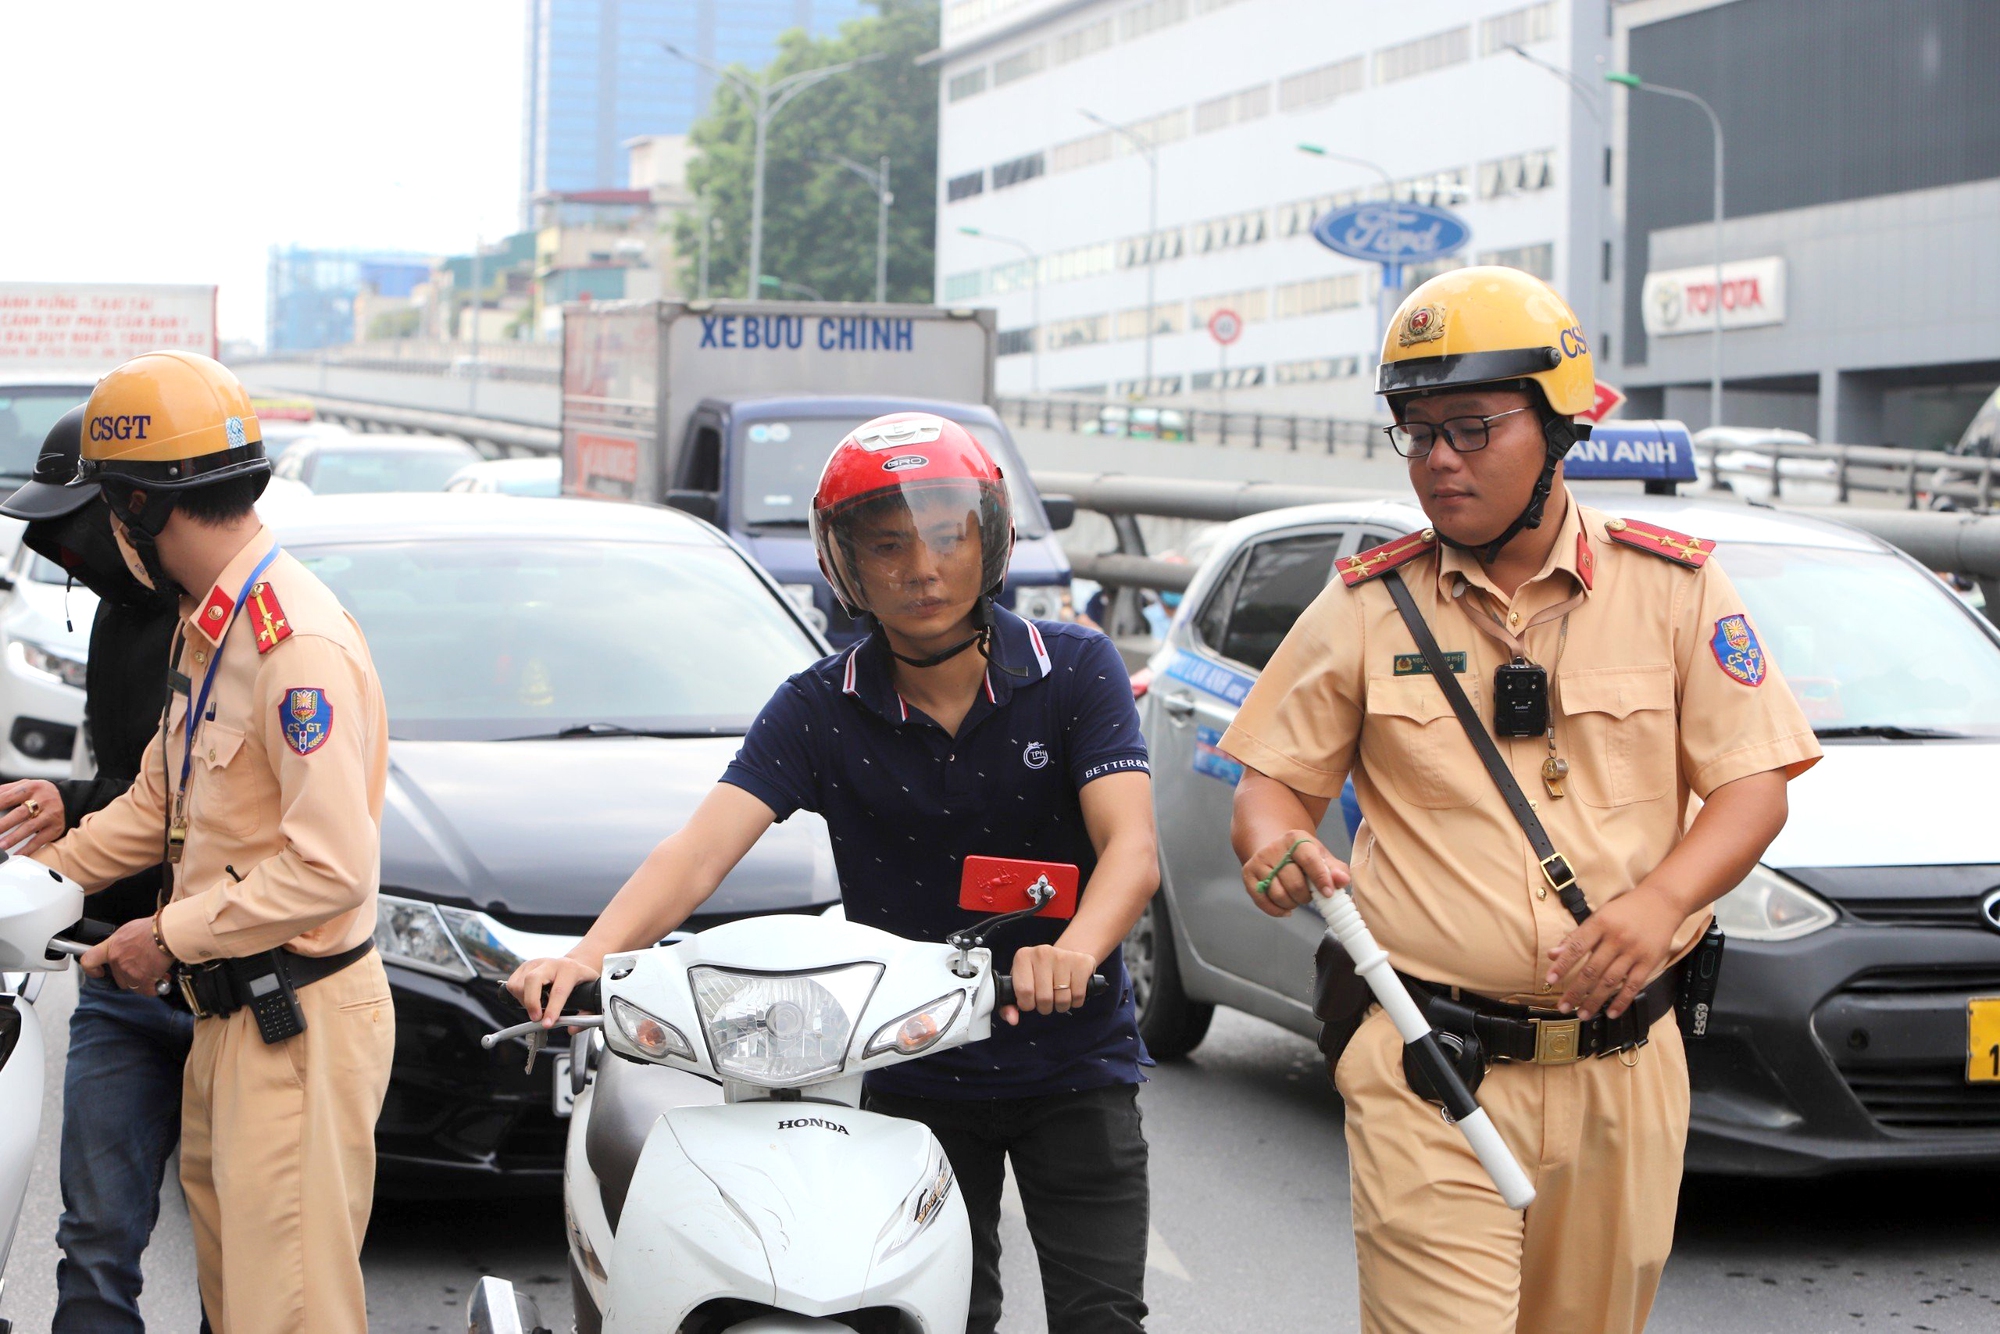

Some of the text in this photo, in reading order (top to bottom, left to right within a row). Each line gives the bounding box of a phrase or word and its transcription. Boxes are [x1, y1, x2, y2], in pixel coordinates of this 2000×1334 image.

[1345, 206, 1442, 252] Ford
[1686, 278, 1763, 315] TOYOTA
[90, 415, 151, 441] CSGT
[1612, 442, 1677, 463] ANH
[1727, 652, 1744, 665] CS
[287, 723, 322, 733] CS GT
[777, 1117, 850, 1137] HONDA
